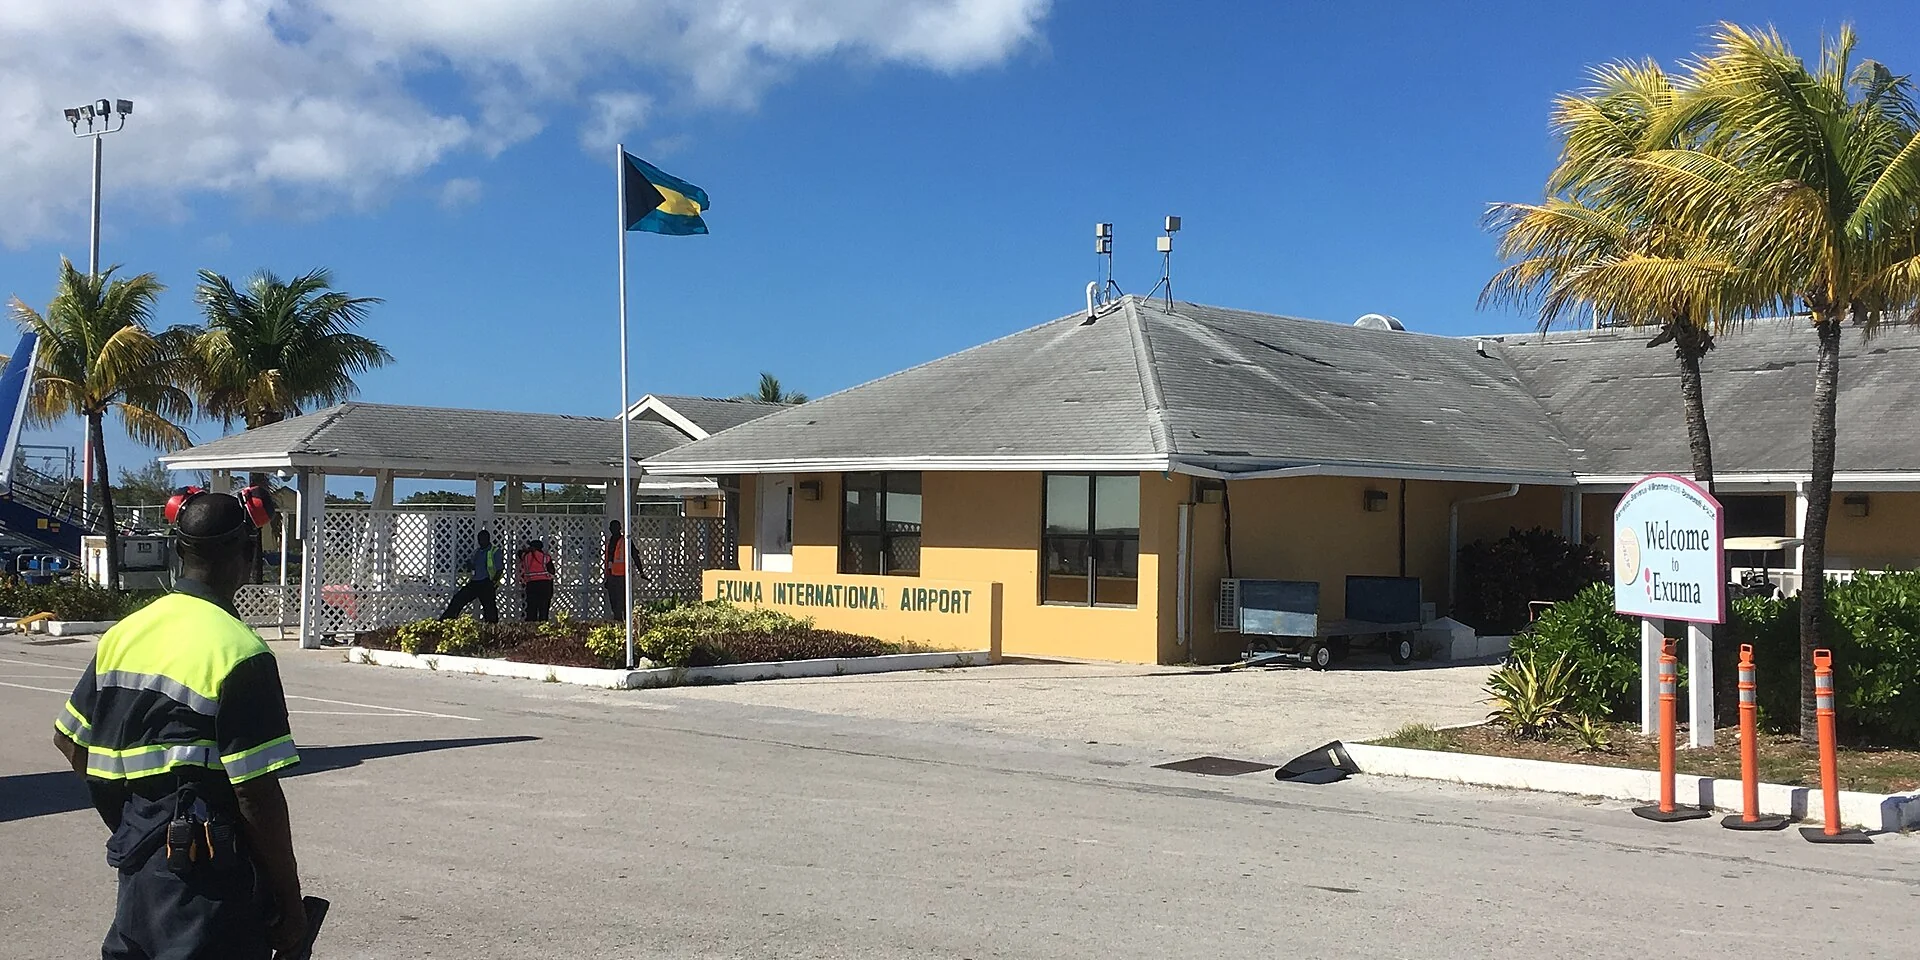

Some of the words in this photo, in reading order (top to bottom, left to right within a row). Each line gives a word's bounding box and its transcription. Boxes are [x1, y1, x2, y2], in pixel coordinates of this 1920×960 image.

[1645, 520, 1709, 551] Welcome
[1671, 556, 1680, 572] to
[717, 580, 763, 603] EXUMA
[900, 587, 972, 614] AIRPORT
[1653, 572, 1702, 604] Exuma
